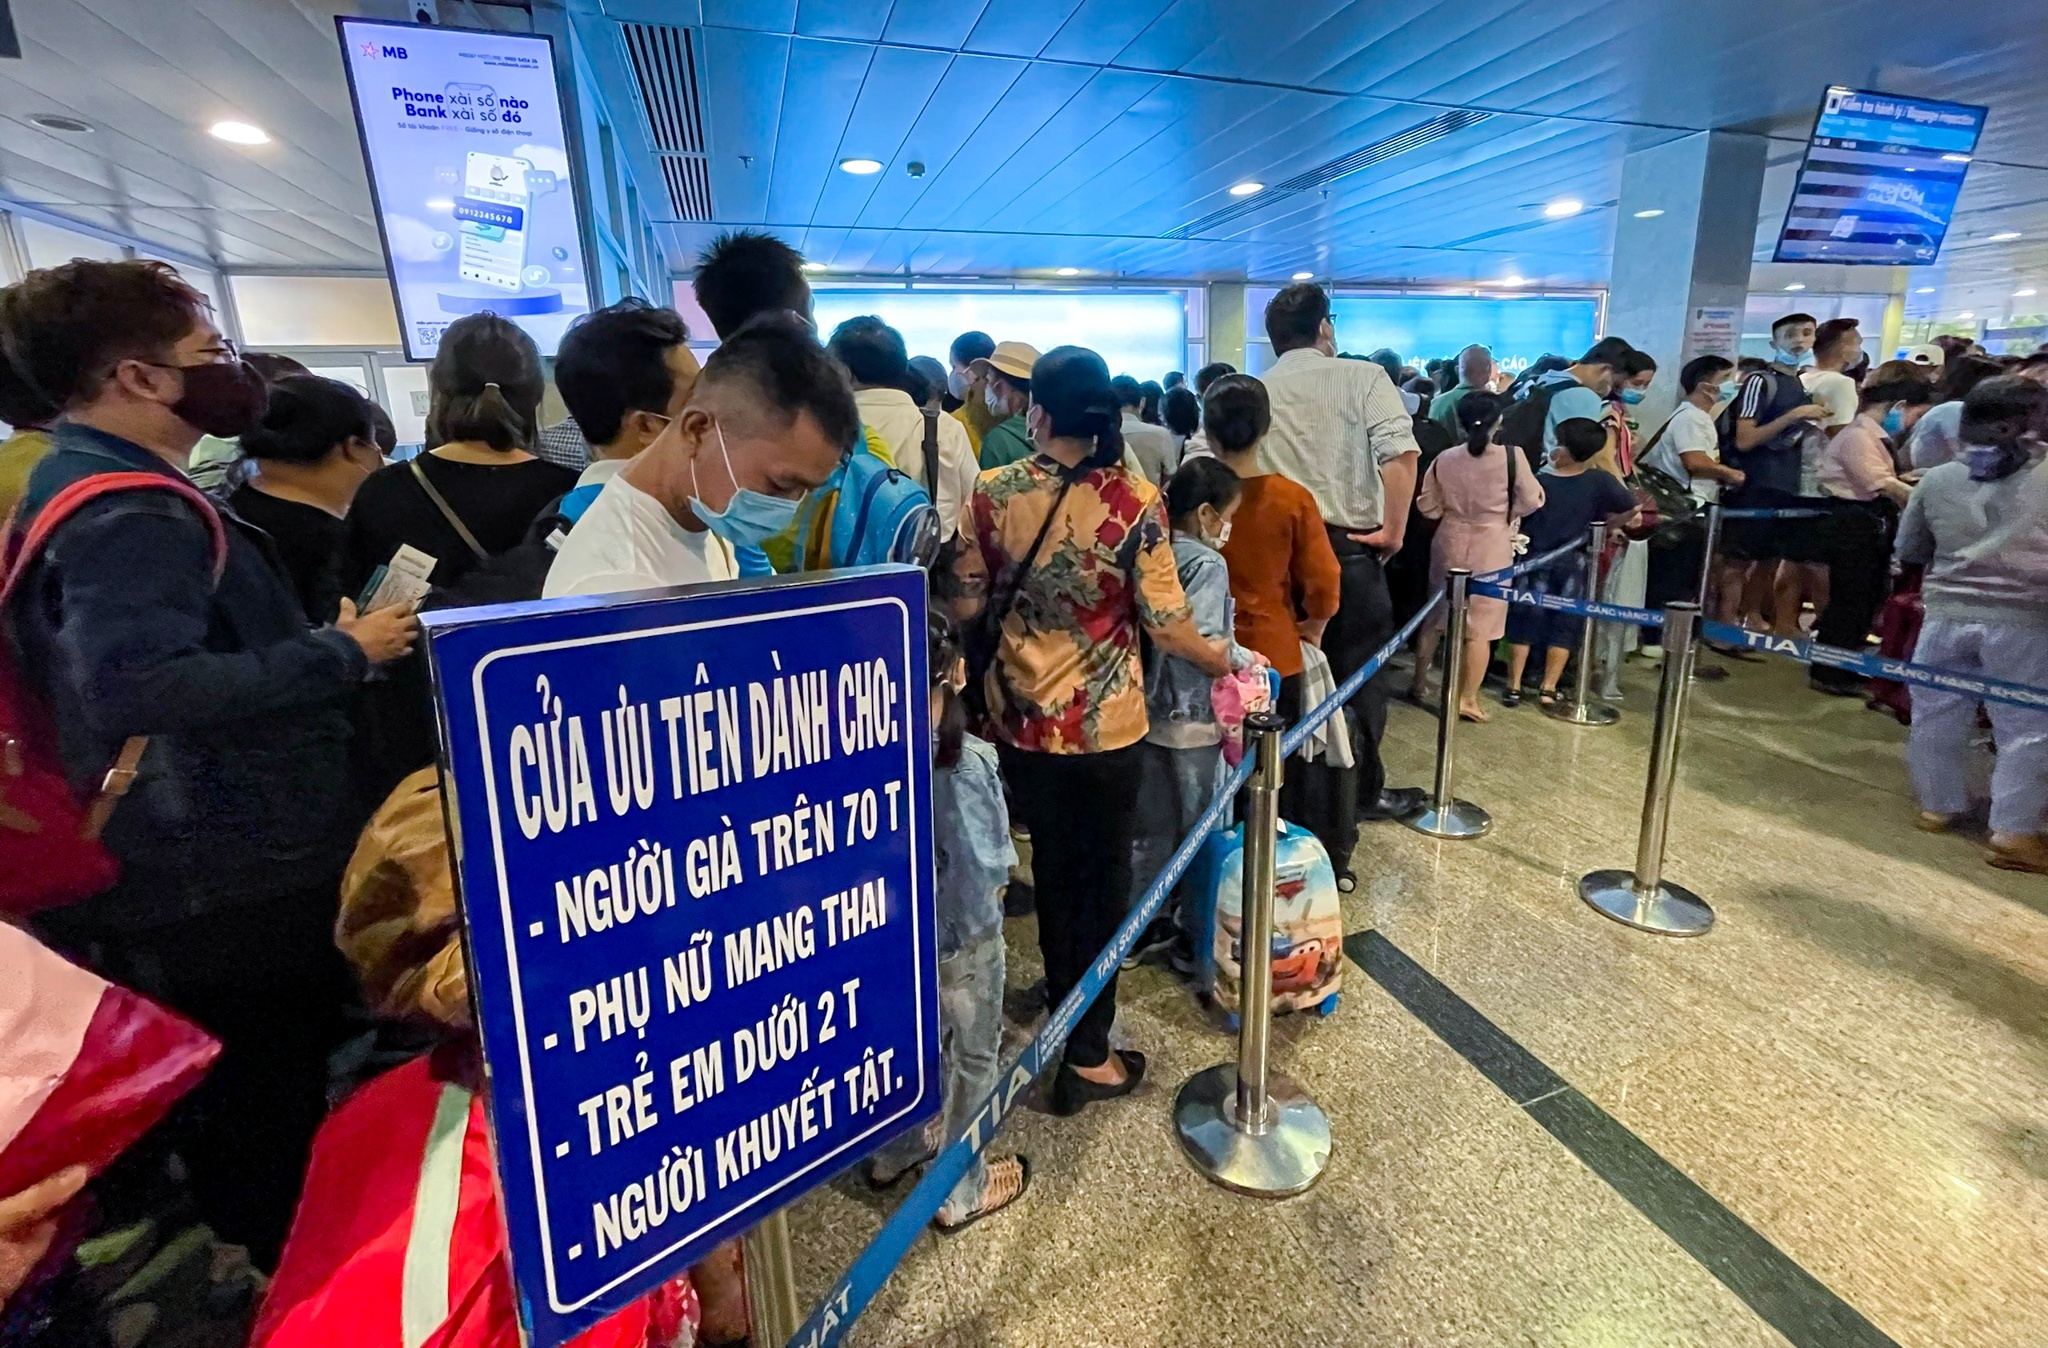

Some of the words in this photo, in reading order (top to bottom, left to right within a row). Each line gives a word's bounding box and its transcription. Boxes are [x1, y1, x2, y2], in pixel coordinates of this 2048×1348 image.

[382, 46, 408, 60] MB
[391, 87, 444, 104] Phone
[449, 93, 473, 106] xài
[477, 93, 495, 107] số
[499, 97, 529, 110] nào
[405, 103, 448, 119] Bank
[452, 108, 475, 120] xài
[480, 107, 498, 122] số
[502, 110, 522, 123] đó
[458, 207, 513, 225] 0912345678
[1501, 354, 1528, 370] CÁO
[1499, 587, 1537, 605] TIA
[1743, 629, 1801, 656] TIA
[1376, 645, 1390, 667] TIA
[510, 674, 597, 840] CỬA
[601, 684, 655, 816] ƯU
[660, 662, 743, 800] TIÊN
[748, 650, 831, 778] DÀNH
[837, 657, 899, 756] CHO:
[555, 839, 675, 944] NGƯỜI
[685, 814, 743, 899] GIÀ
[750, 793, 834, 876] TRÊN
[844, 788, 878, 847] 70
[885, 780, 902, 832] T
[569, 966, 651, 1053] PHỤ
[663, 933, 713, 1014] NỮ
[724, 905, 815, 989] MANG
[822, 877, 887, 947] THAI
[960, 1064, 1033, 1154] TIA
[1096, 945, 1117, 980] TAN
[1118, 915, 1140, 952] SON
[1140, 881, 1164, 922] NHAT
[1164, 805, 1219, 888] INTERNATIONAL
[578, 1051, 658, 1156] TRẺ
[670, 1040, 724, 1115] EM
[733, 994, 809, 1084] DƯỚI
[819, 990, 837, 1044] 2
[842, 978, 861, 1029] T
[592, 1146, 706, 1259] NGƯỜI
[714, 1066, 837, 1190] KHUYẾT
[843, 1046, 903, 1115] TẬT.
